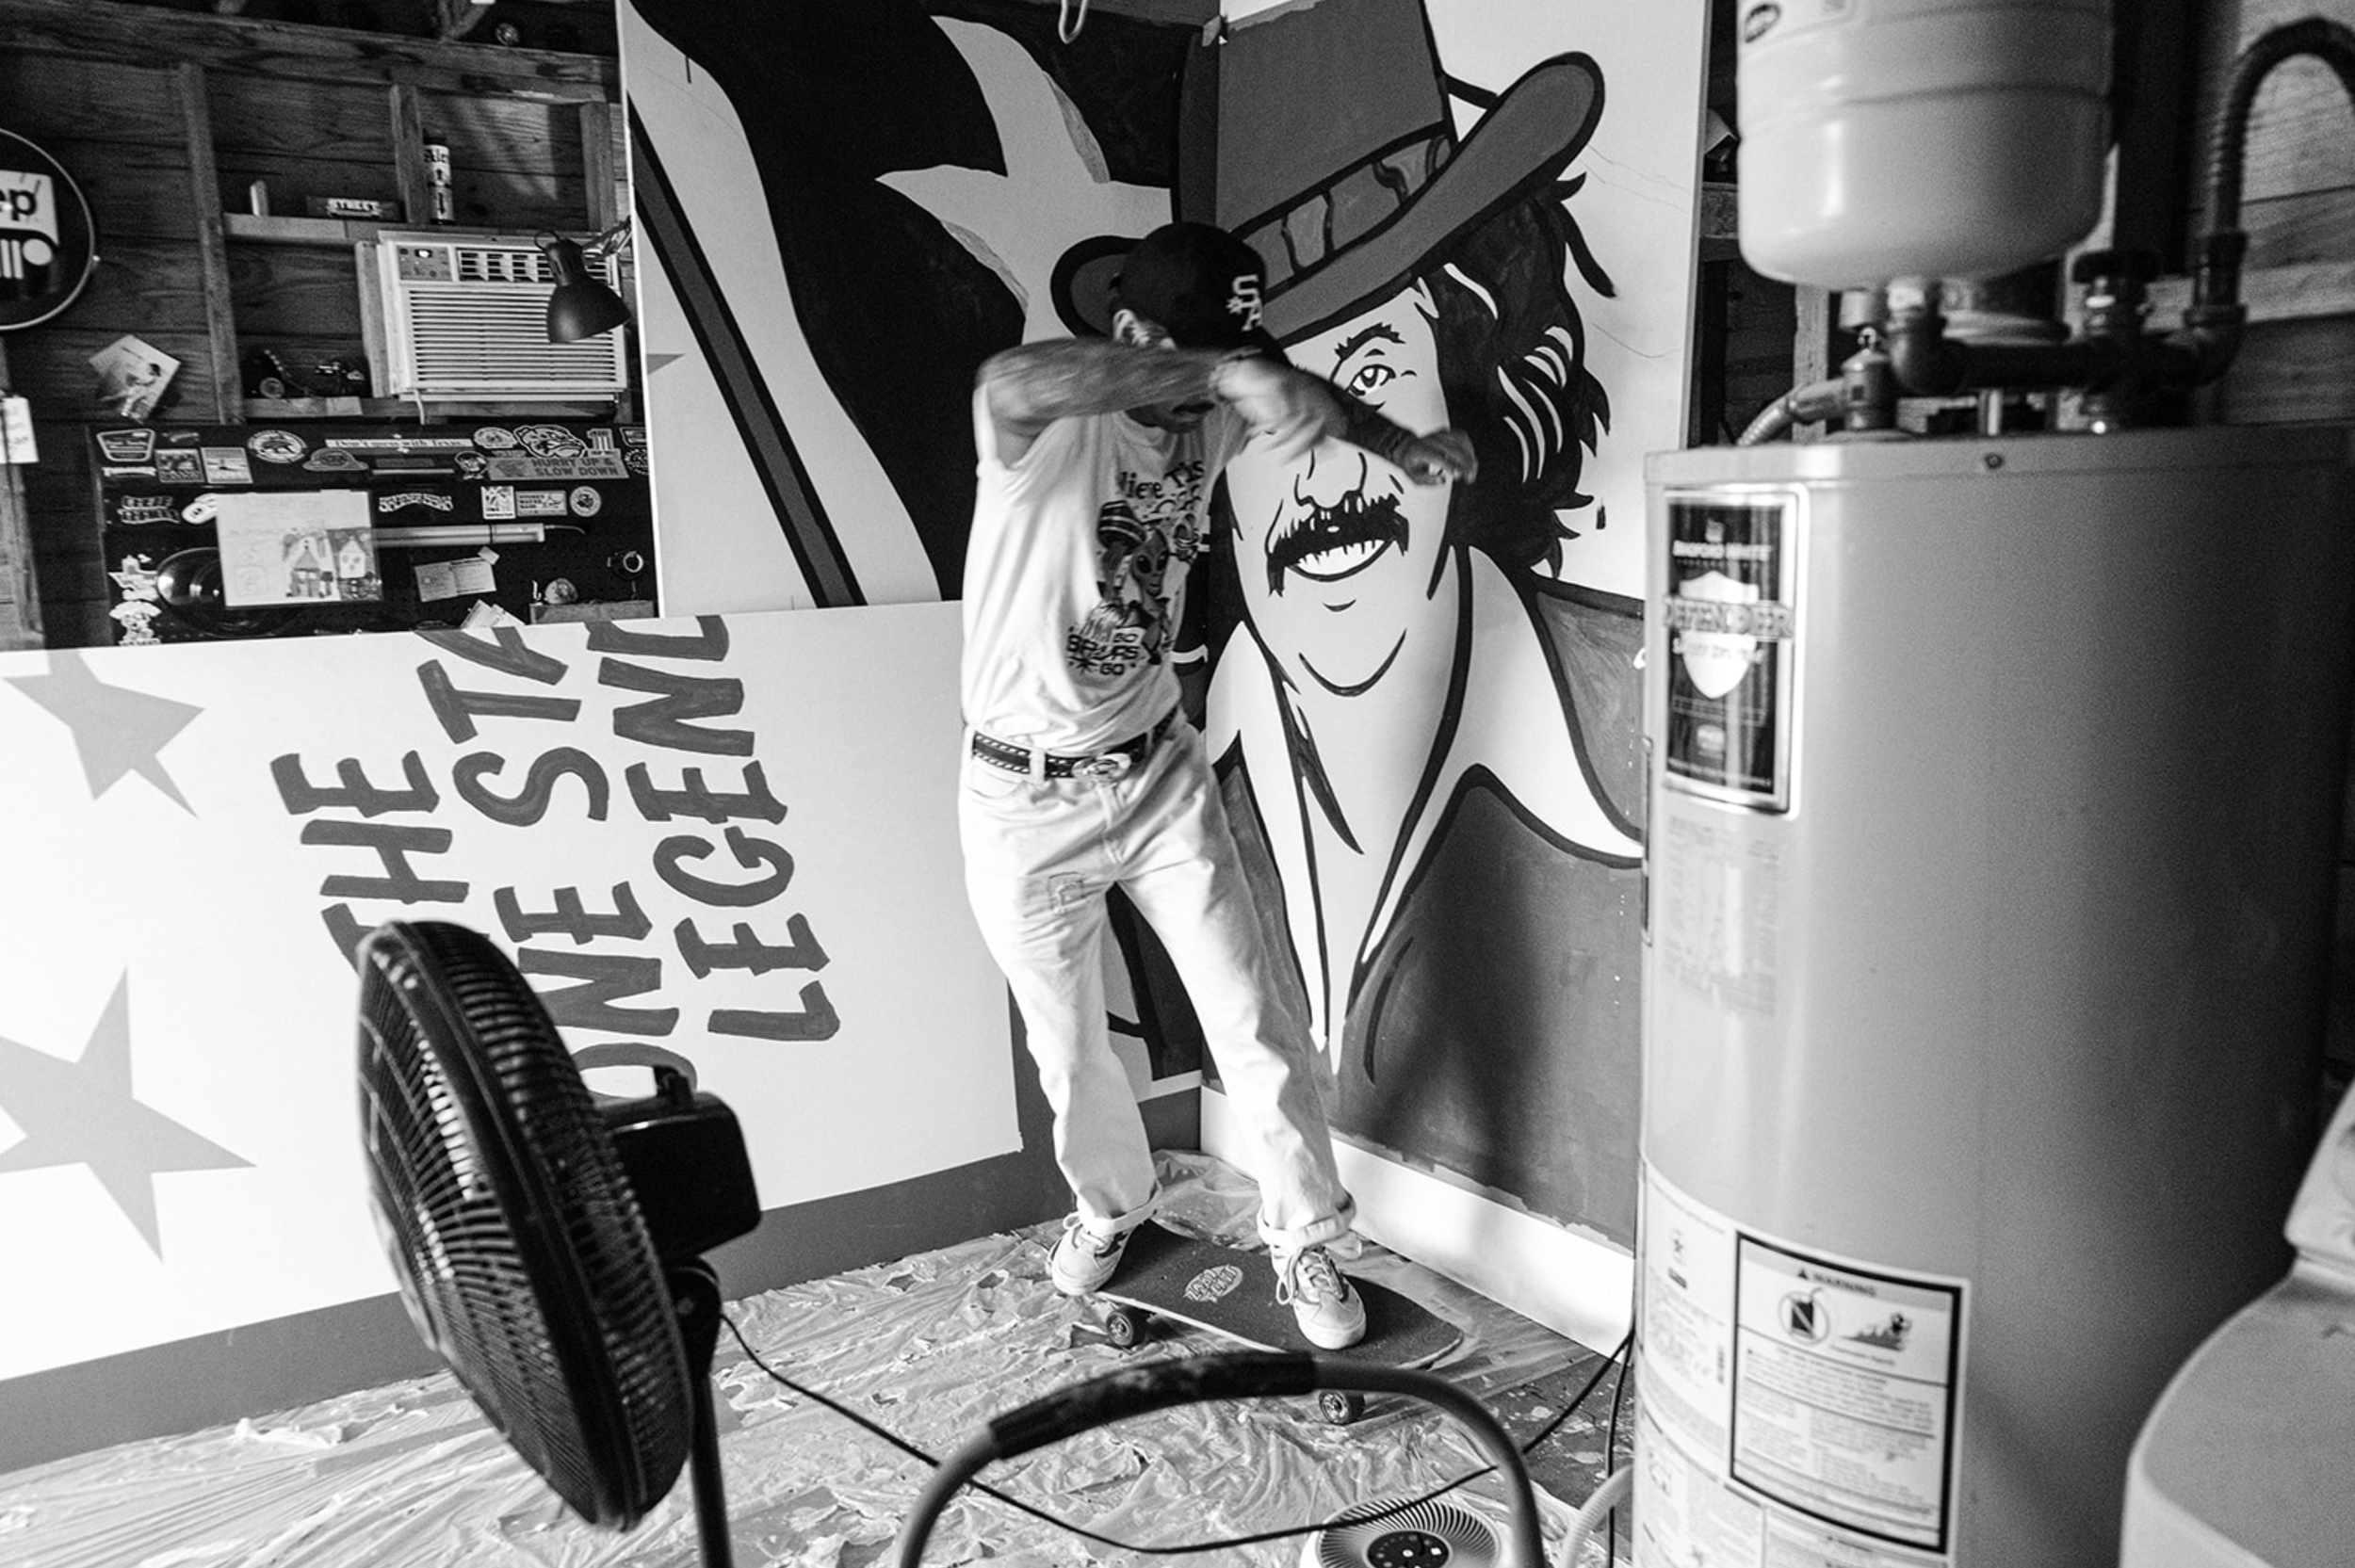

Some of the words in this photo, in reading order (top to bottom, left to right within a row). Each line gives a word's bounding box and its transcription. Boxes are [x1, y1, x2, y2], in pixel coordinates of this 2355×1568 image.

[581, 459, 600, 467] UP
[534, 467, 574, 477] SLOW
[578, 467, 620, 477] DOWN
[1099, 662, 1126, 676] GO
[269, 750, 490, 977] HE
